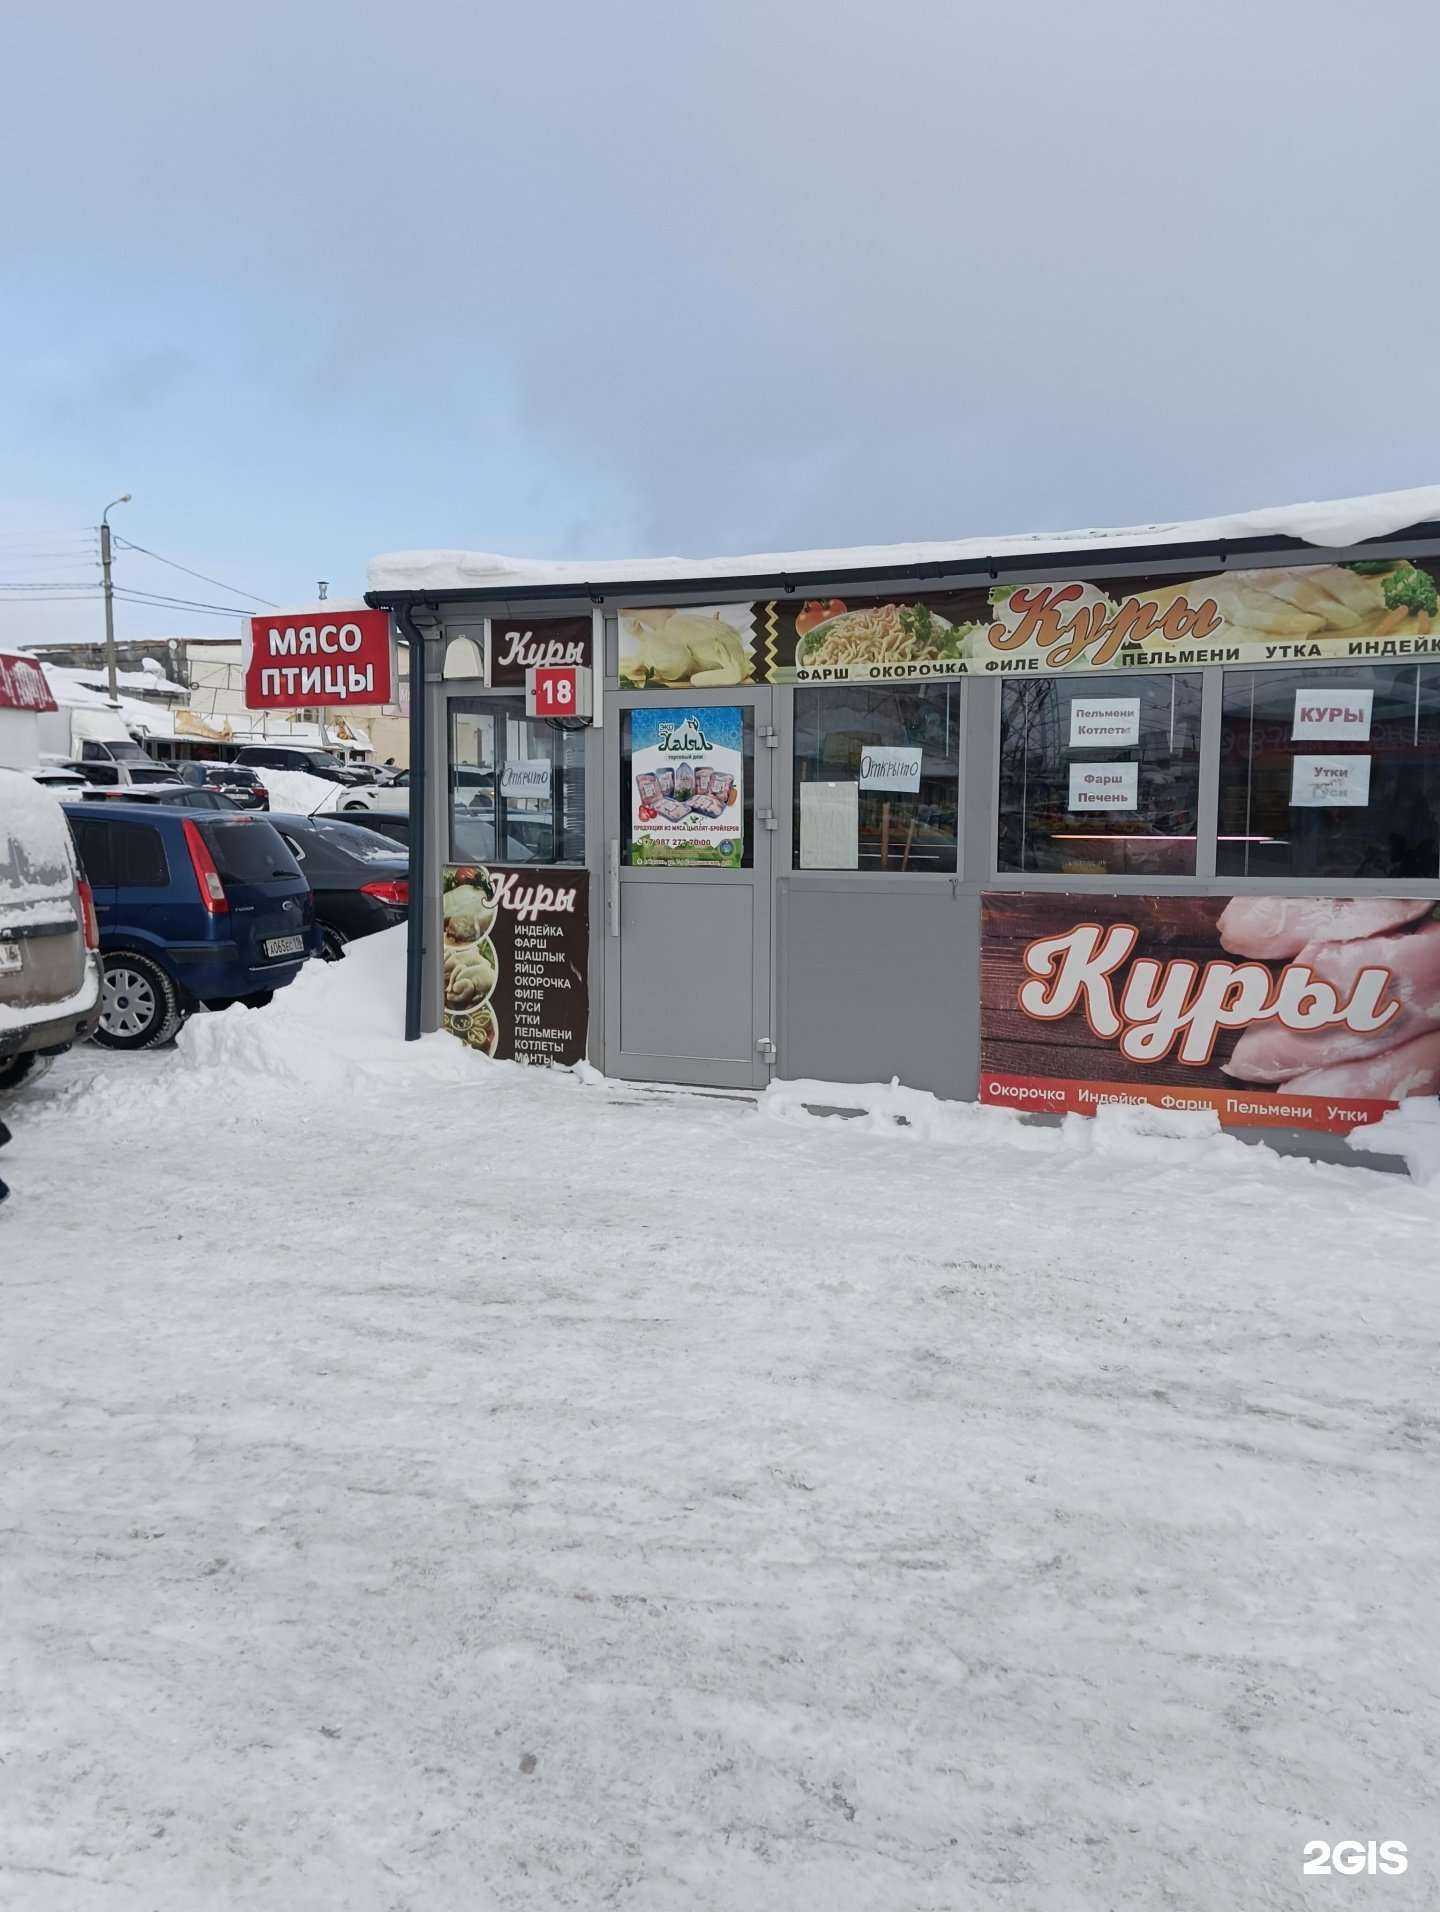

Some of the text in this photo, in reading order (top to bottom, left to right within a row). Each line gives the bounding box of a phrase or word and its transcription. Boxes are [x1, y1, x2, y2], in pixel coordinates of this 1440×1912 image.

[988, 584, 1223, 668] Куры
[268, 623, 363, 656] МЯСО
[498, 632, 585, 668] Куры
[797, 667, 849, 681] ФАРШ
[869, 662, 969, 678] ОКОРОЧКА
[985, 658, 1039, 672] ФИЛЕ
[1121, 647, 1240, 666] ПЕЛЬМЕНИ
[1265, 643, 1322, 659] УТКА
[261, 663, 374, 699] ПТИЦЫ
[542, 680, 572, 704] 18
[1076, 709, 1135, 719] Пельмени
[1300, 707, 1365, 723] КУРЫ
[861, 756, 919, 779] Открыто
[1313, 766, 1349, 778] Утки
[502, 768, 548, 787] Открыто
[1084, 774, 1123, 786] Фарш
[1078, 793, 1129, 803] Печень
[481, 873, 577, 921] Куры
[514, 924, 564, 937] ИНДЕЙКА
[514, 938, 547, 949] ФАРШ
[514, 951, 565, 963] ШАШЛЫК
[514, 963, 544, 975] ЯЙЦО
[514, 976, 571, 989] ОКОРОЧКА
[514, 989, 544, 1000] ФИЛЕ
[1018, 922, 1400, 1066] Куры
[514, 1002, 541, 1012] ГУСИ
[514, 1014, 540, 1025] УТКИ
[514, 1027, 572, 1041] ПЕЛЬМЕНИ
[514, 1040, 564, 1053] КОТЛЕТЫ
[989, 1082, 1066, 1101] Окорочка
[1161, 1095, 1212, 1111] Фарш
[1227, 1099, 1313, 1119] Пельмени
[1328, 1105, 1369, 1123] Утки
